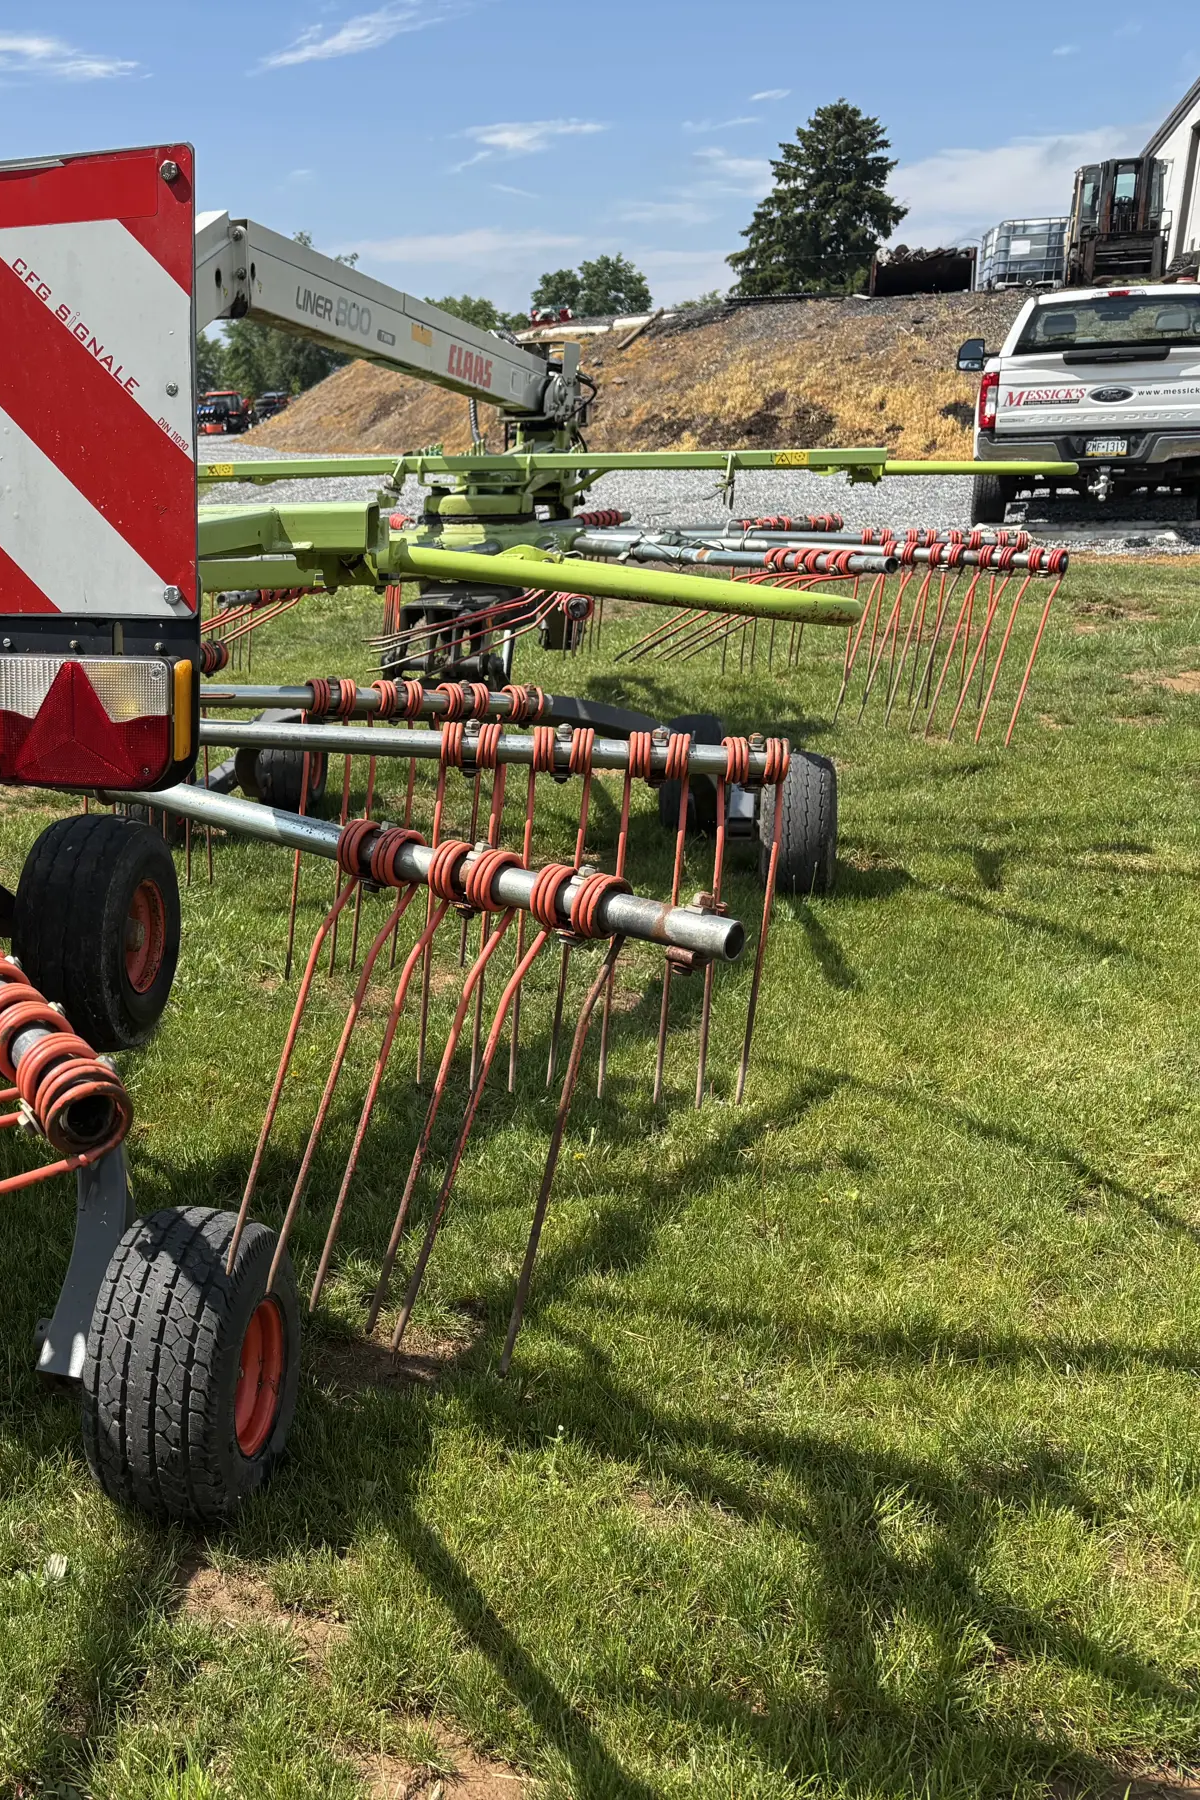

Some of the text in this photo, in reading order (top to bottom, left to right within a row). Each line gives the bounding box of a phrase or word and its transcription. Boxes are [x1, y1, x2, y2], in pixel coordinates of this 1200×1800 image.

[11, 257, 52, 302] CFG
[295, 286, 372, 336] LINER 800
[447, 344, 493, 389] CLAAS
[1001, 387, 1087, 407] MESSICK'S
[157, 417, 190, 452] DIN 11030
[1028, 413, 1117, 424] SUPER
[1123, 411, 1193, 421] DUTY
